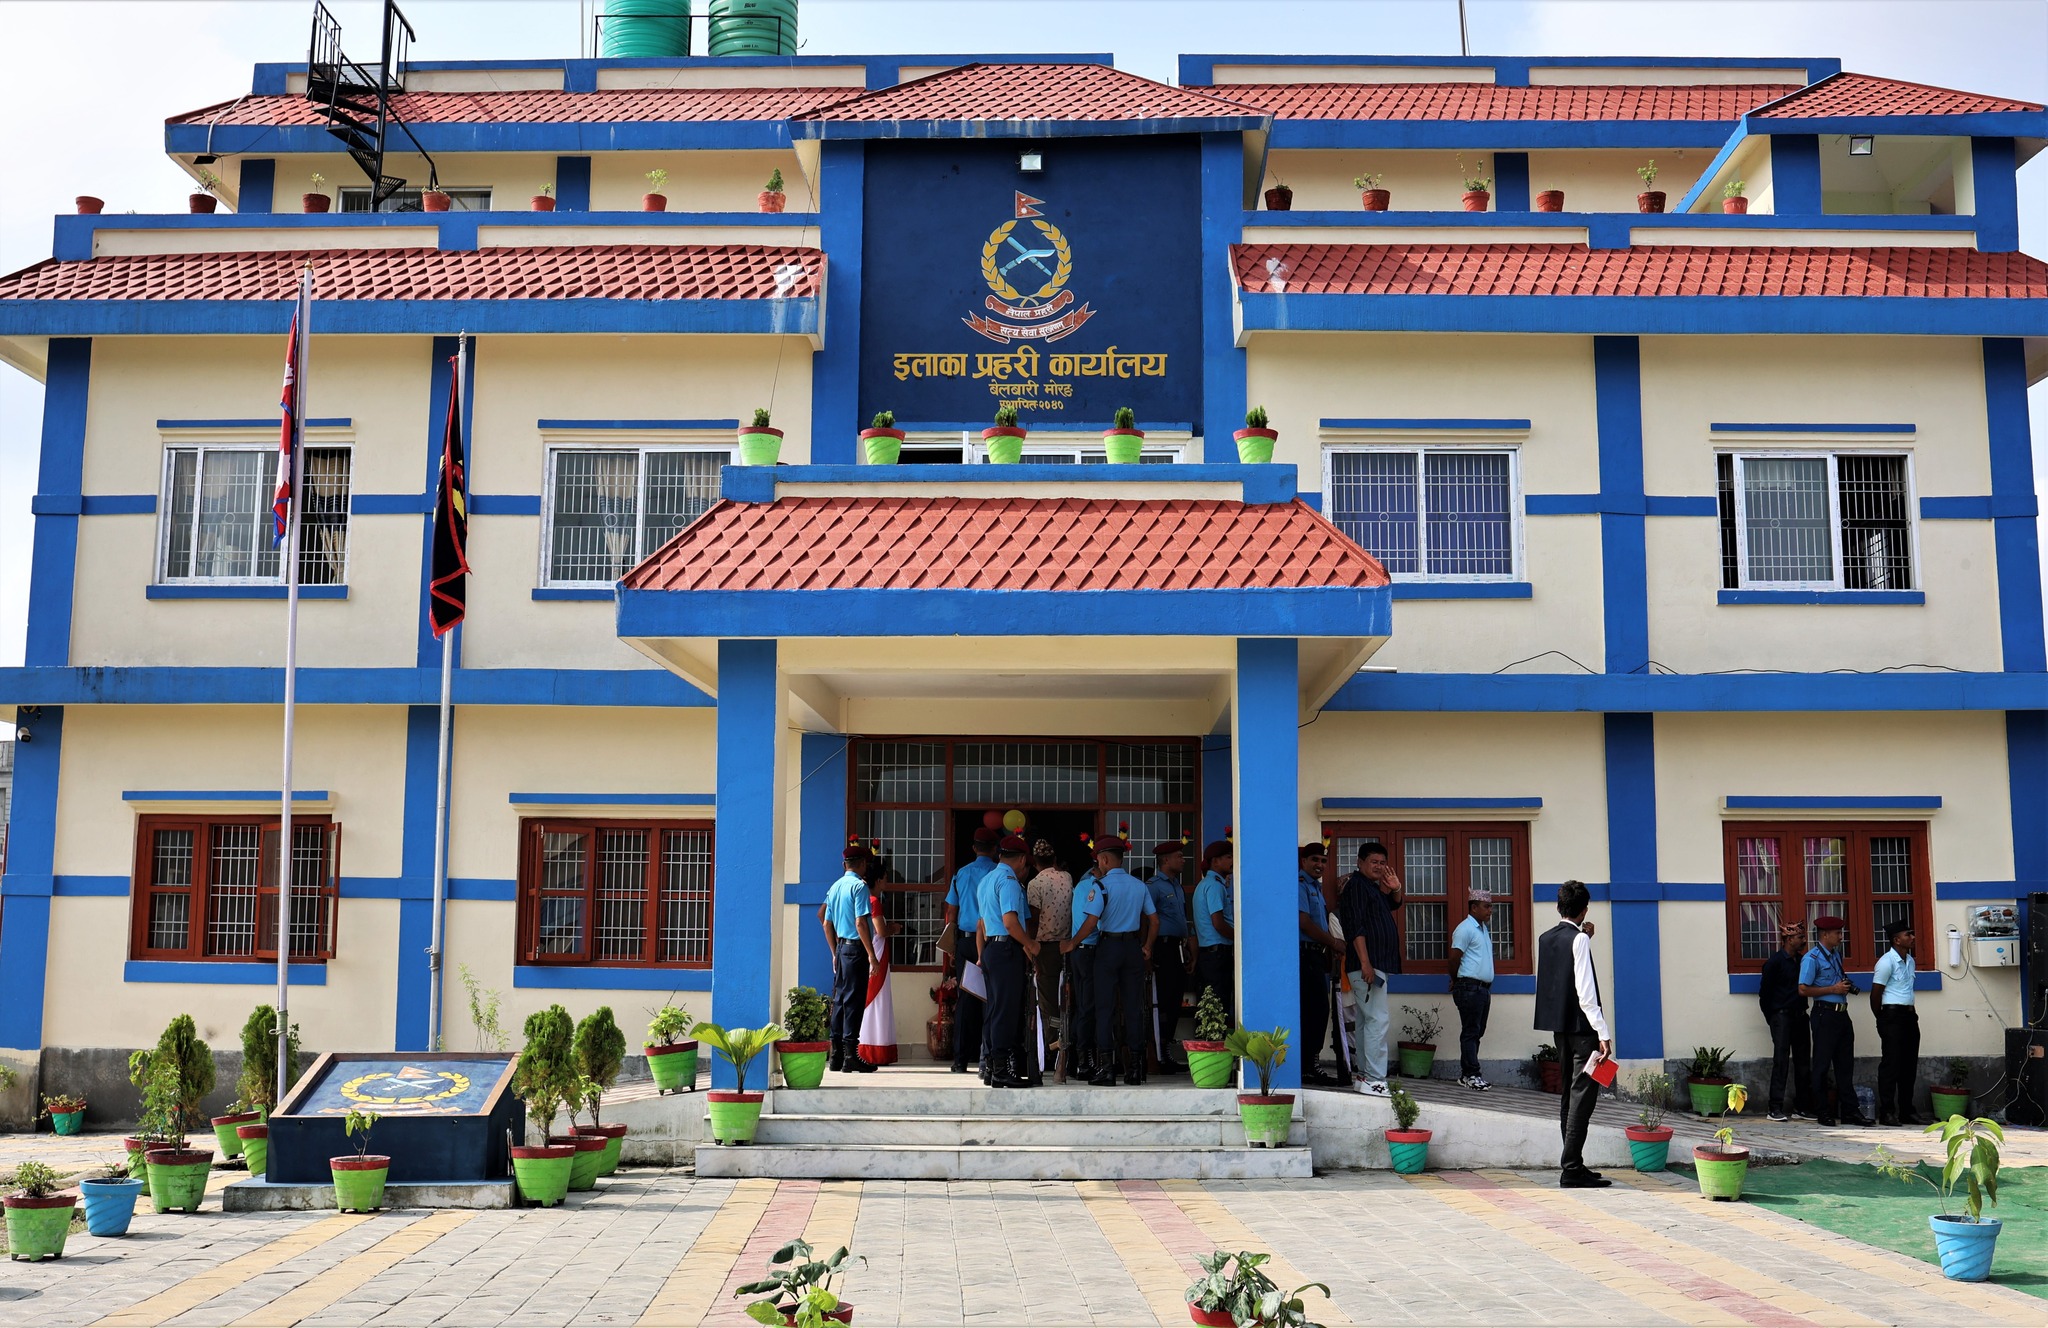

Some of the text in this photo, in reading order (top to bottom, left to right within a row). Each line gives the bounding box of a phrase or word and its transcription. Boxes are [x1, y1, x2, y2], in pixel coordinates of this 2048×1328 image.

[1034, 304, 1053, 316] प्रहरी
[1021, 327, 1037, 337] सेवा
[893, 344, 1168, 381] इलाका प्रहरी कार्यालय
[988, 379, 1074, 398] बेलबारी मोरङ
